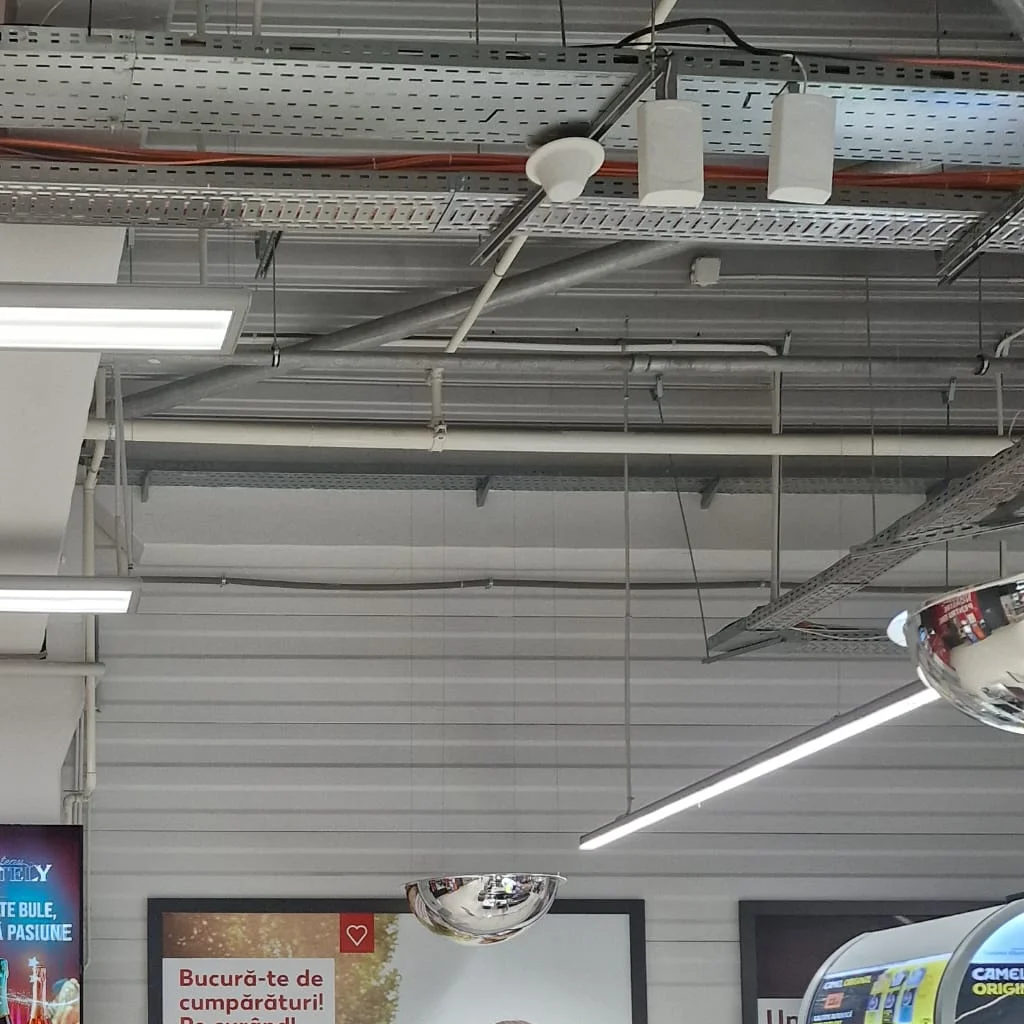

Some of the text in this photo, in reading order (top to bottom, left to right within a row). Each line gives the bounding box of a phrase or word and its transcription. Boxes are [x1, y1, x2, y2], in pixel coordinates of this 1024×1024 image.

[19, 902, 56, 920] BULE,
[7, 924, 72, 941] PASIUNE
[179, 969, 323, 987] Bucură-te de
[179, 993, 323, 1015] cumpărături!
